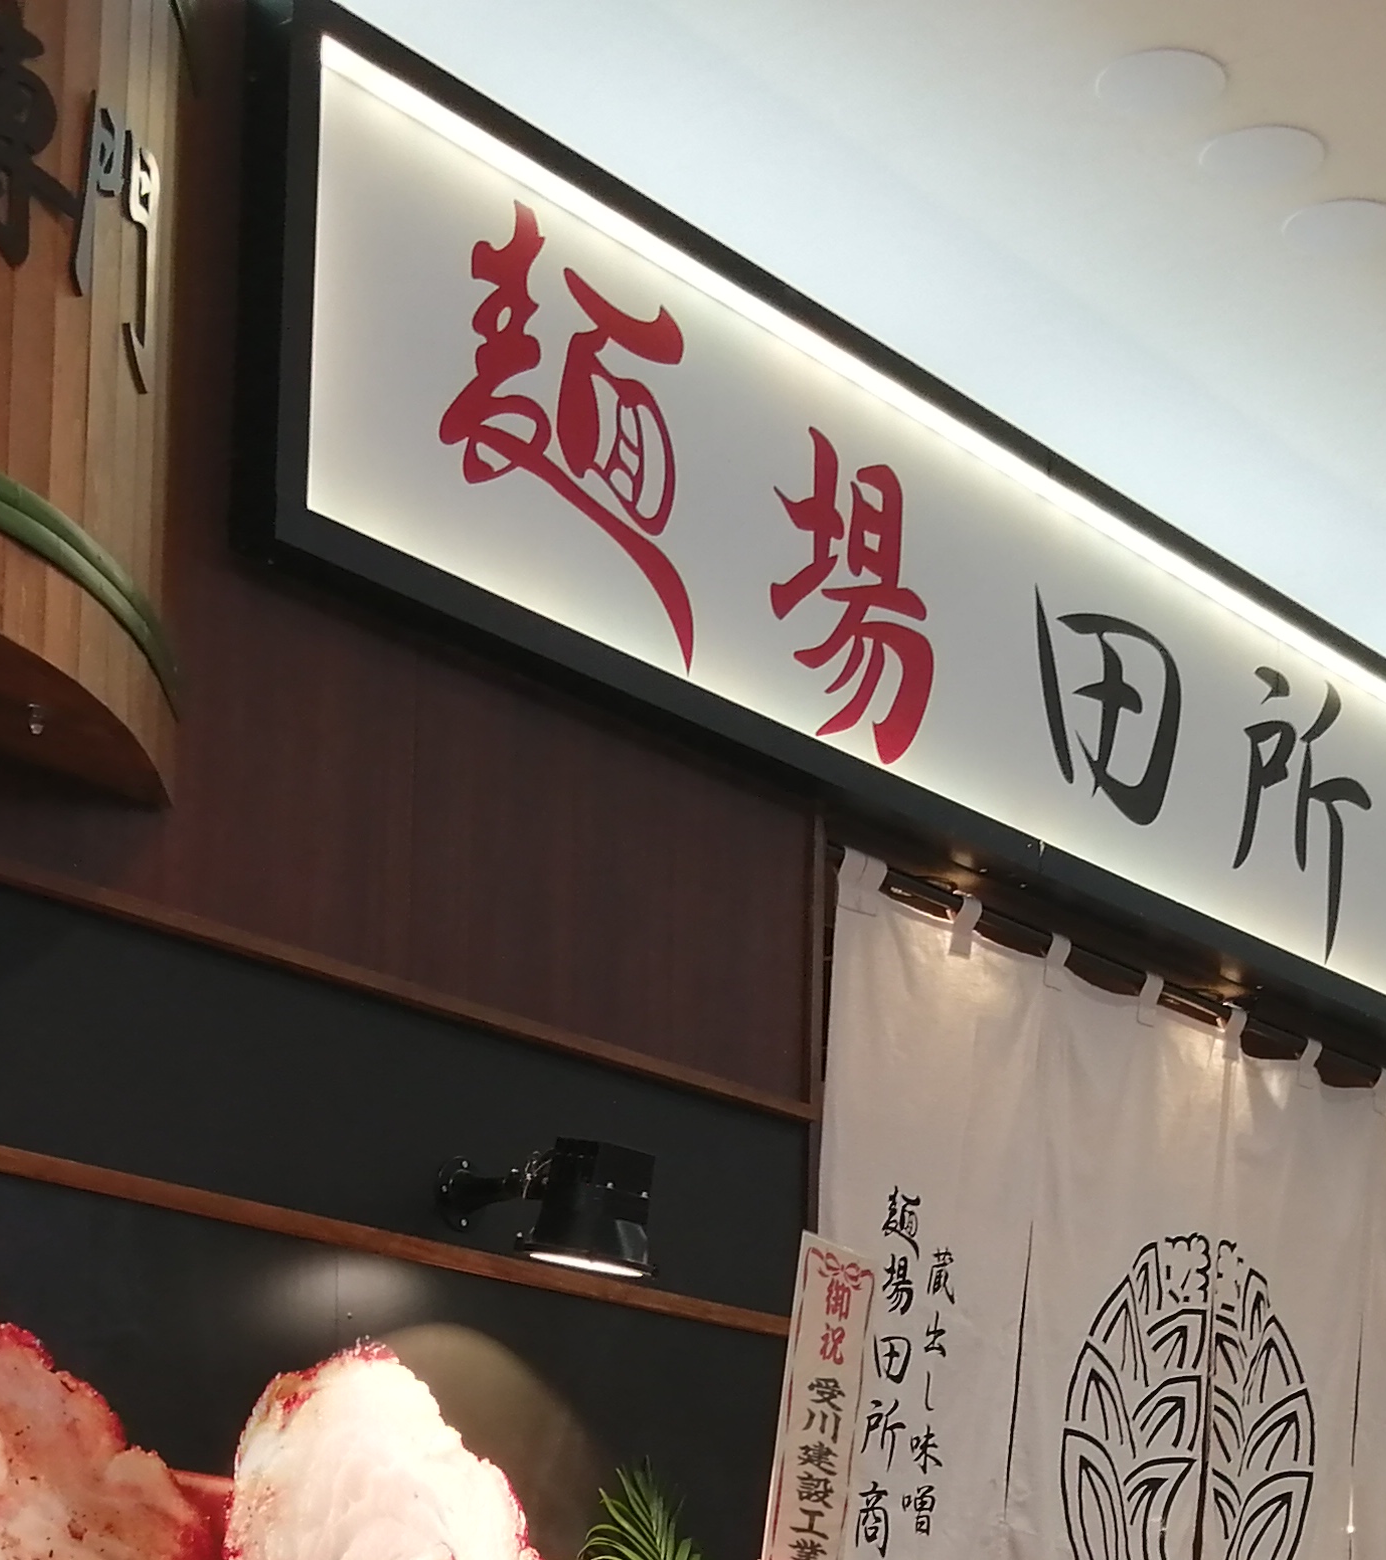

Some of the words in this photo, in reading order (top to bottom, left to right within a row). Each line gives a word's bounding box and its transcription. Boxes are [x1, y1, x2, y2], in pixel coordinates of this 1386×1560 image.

[820, 1281, 851, 1366] 御祝
[901, 1247, 955, 1537] 蔵出し味噌
